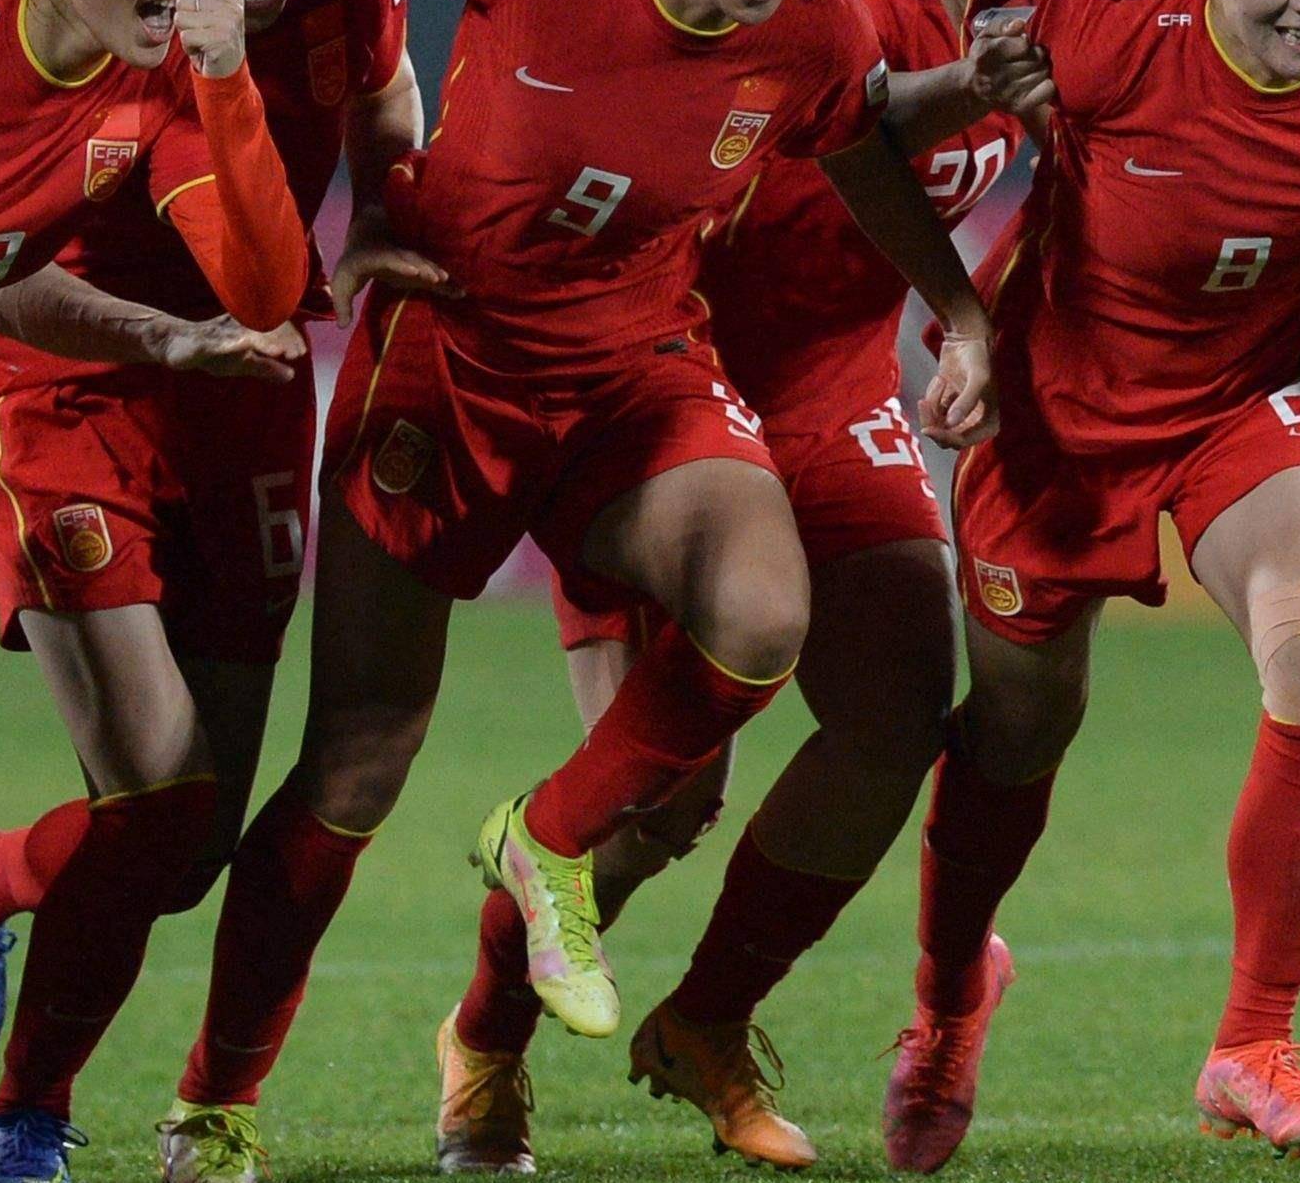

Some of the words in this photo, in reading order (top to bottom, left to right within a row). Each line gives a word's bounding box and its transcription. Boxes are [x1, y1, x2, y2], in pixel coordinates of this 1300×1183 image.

[1157, 14, 1191, 26] CFA
[729, 116, 763, 128] CFA
[94, 146, 131, 159] CFA
[547, 166, 632, 237] 9
[1204, 237, 1271, 292] 8
[252, 469, 303, 578] 6
